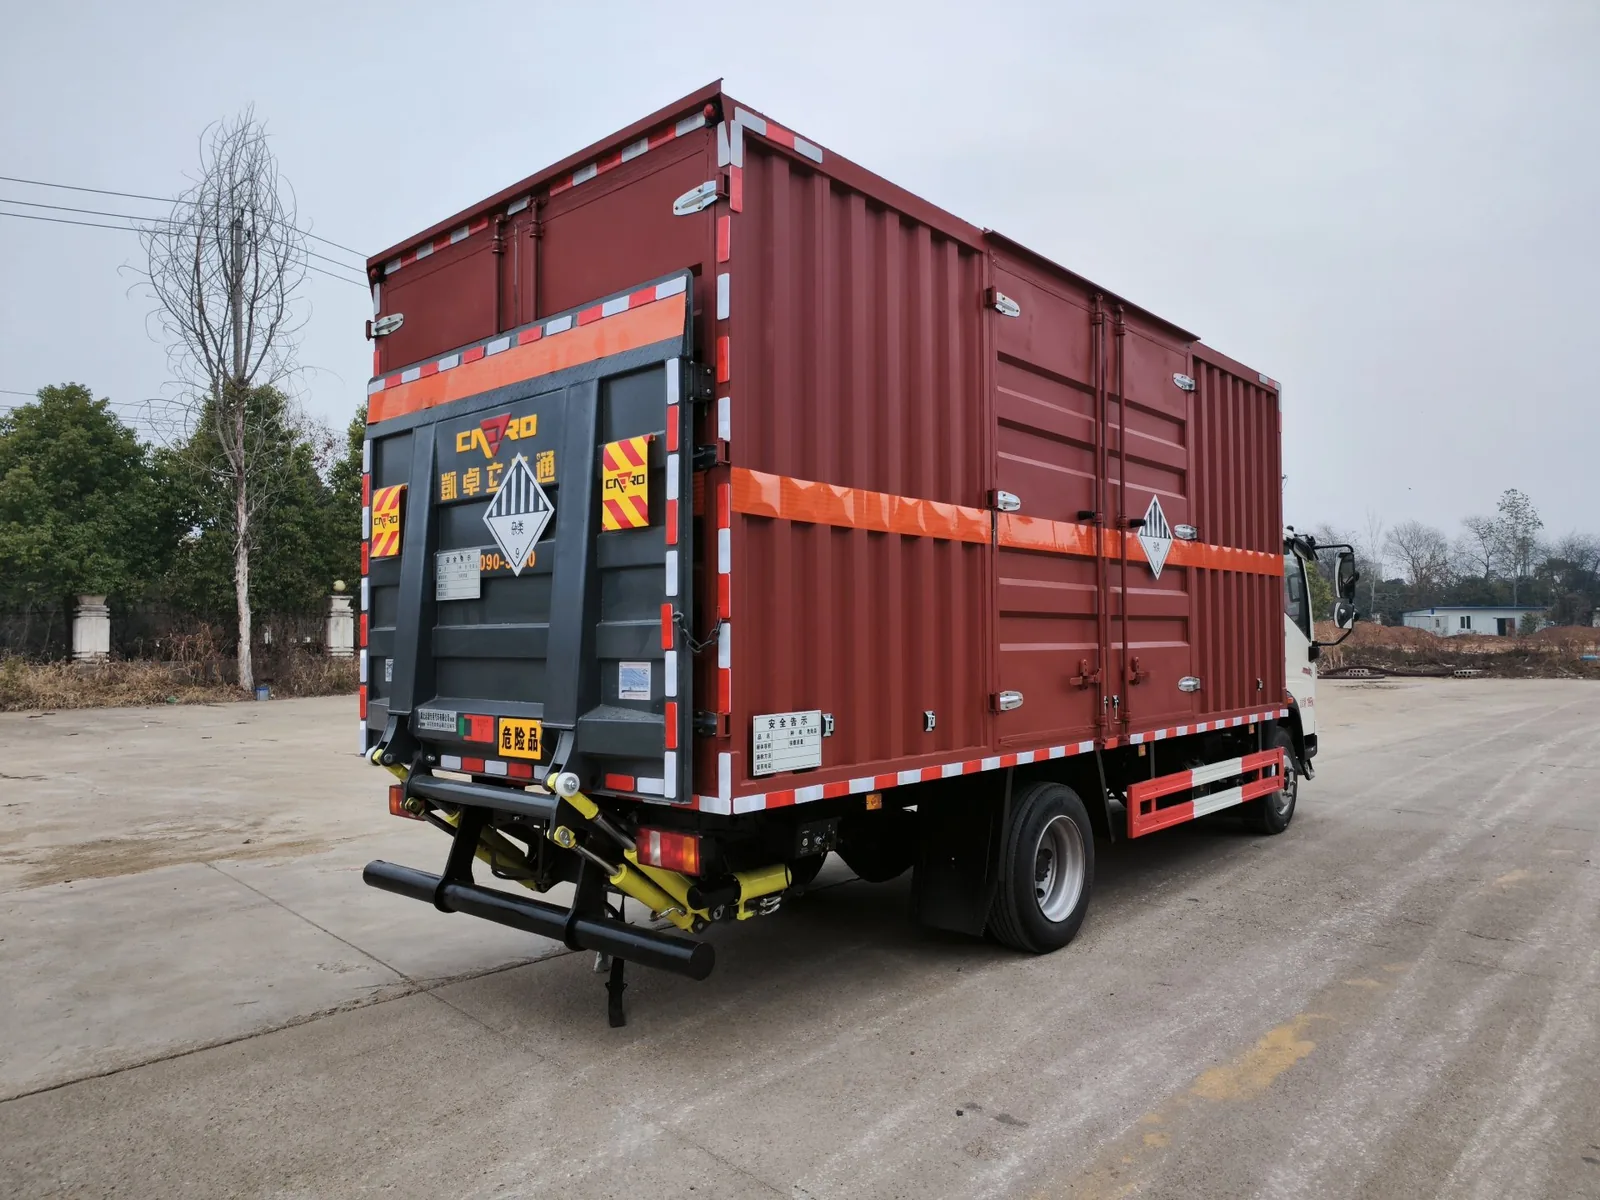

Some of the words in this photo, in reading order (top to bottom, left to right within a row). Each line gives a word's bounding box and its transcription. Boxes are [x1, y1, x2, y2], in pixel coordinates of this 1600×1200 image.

[441, 450, 556, 501] 凱卓立通
[768, 715, 808, 730] 安全告示
[501, 725, 538, 752] 危险品
